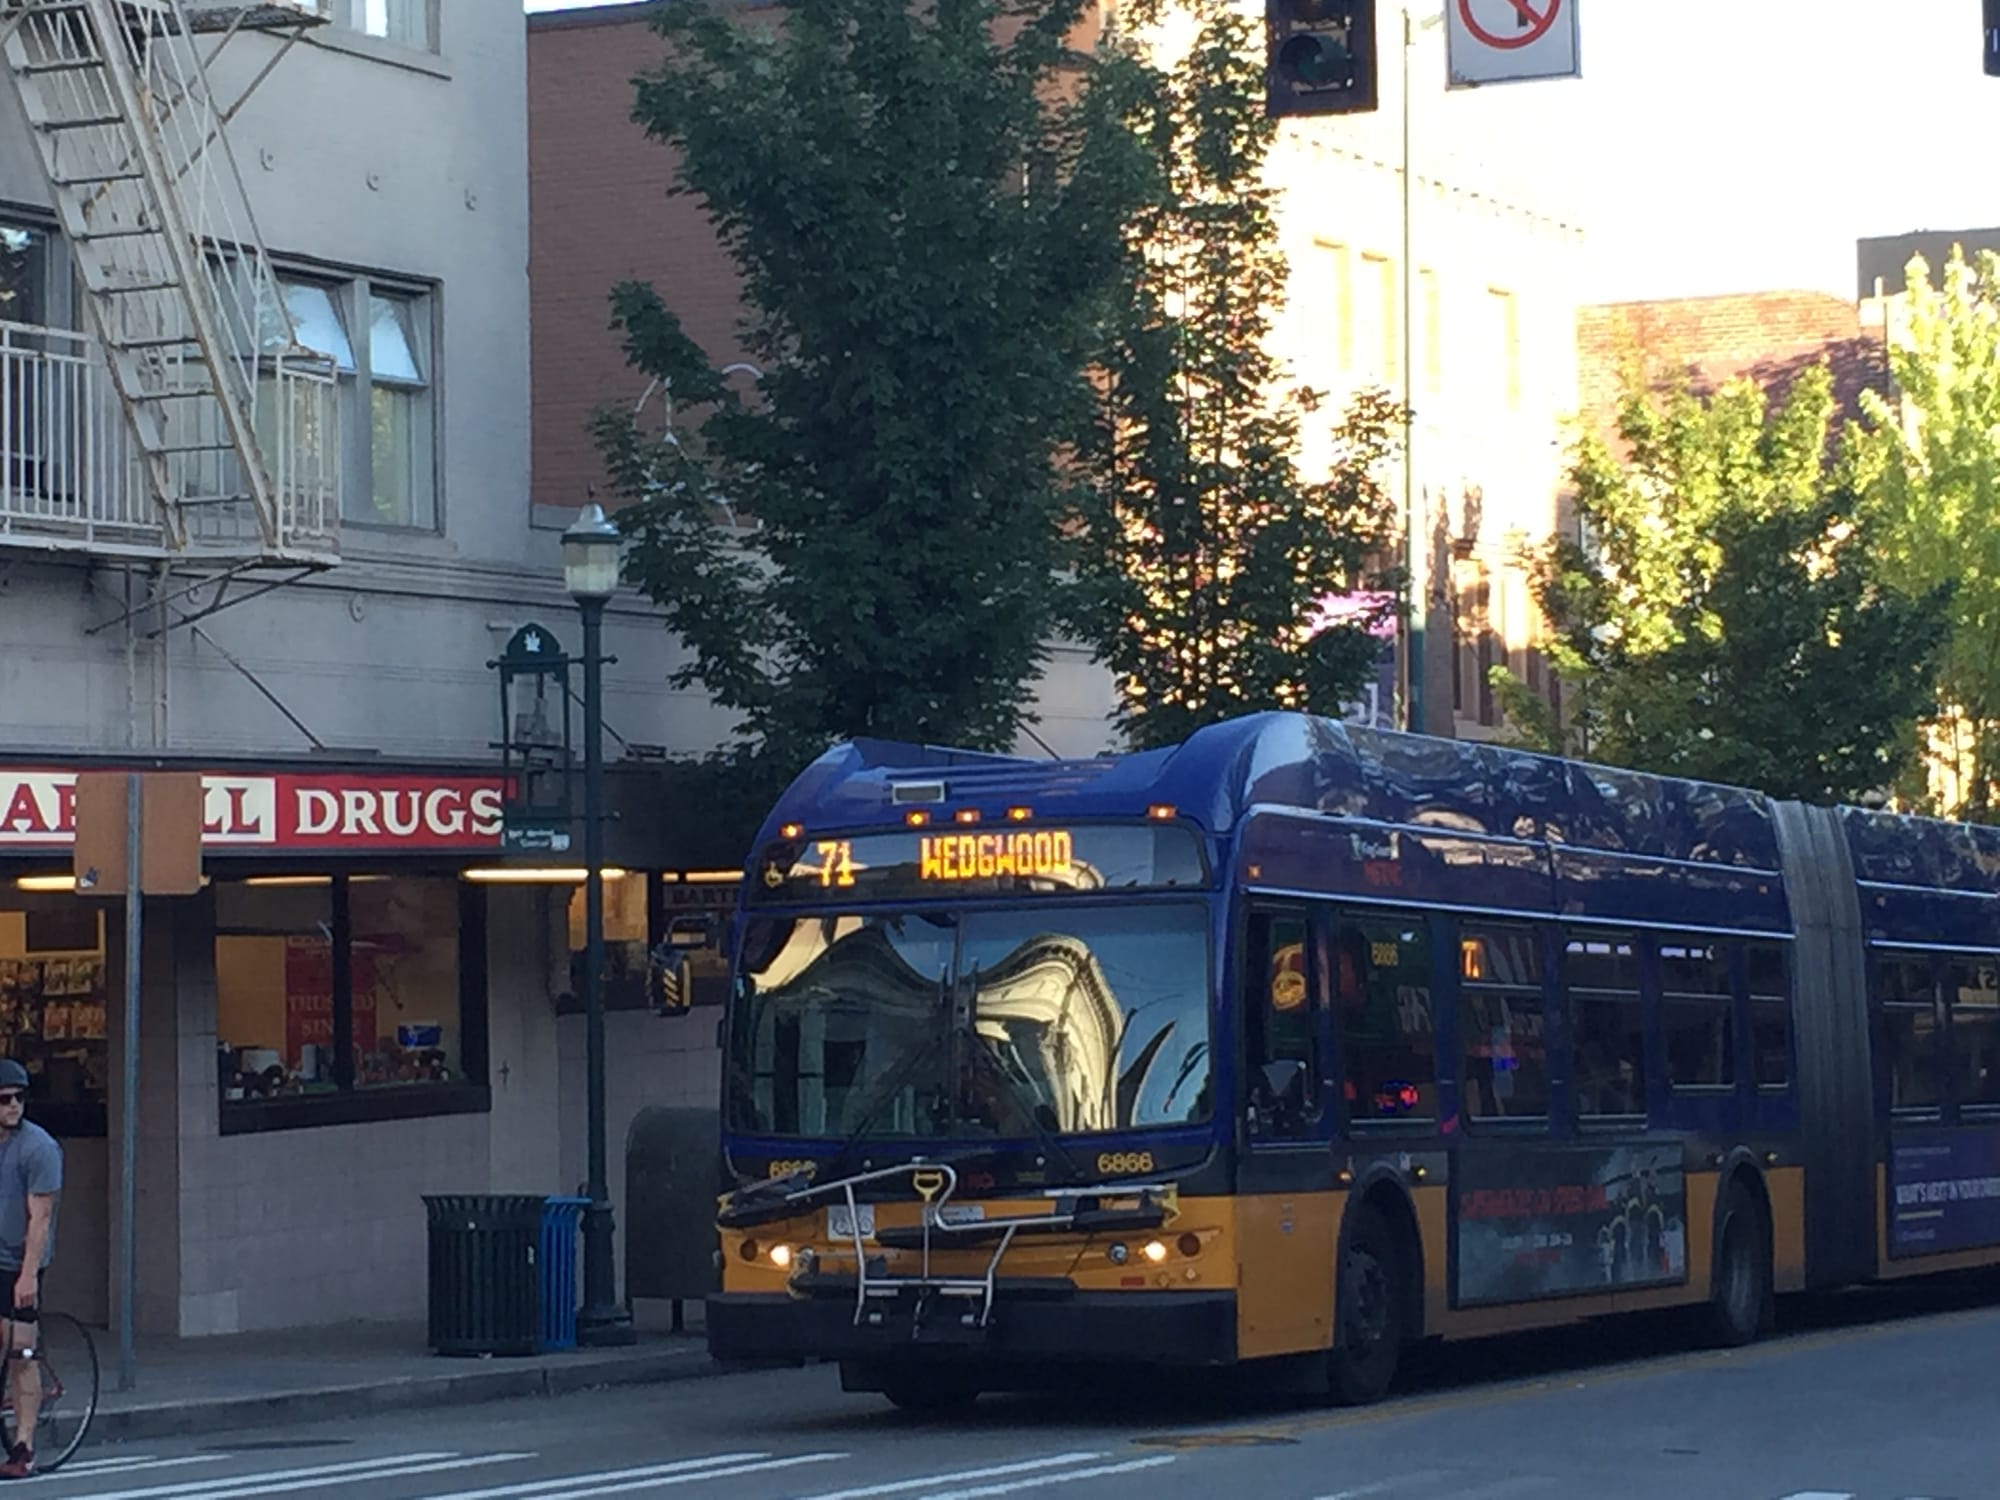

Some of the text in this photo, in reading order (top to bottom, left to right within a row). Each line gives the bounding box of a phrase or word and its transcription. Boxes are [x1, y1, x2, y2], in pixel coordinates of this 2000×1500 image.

[294, 788, 504, 835] DRUGS
[817, 831, 1072, 887] 71 WEDGWOOD
